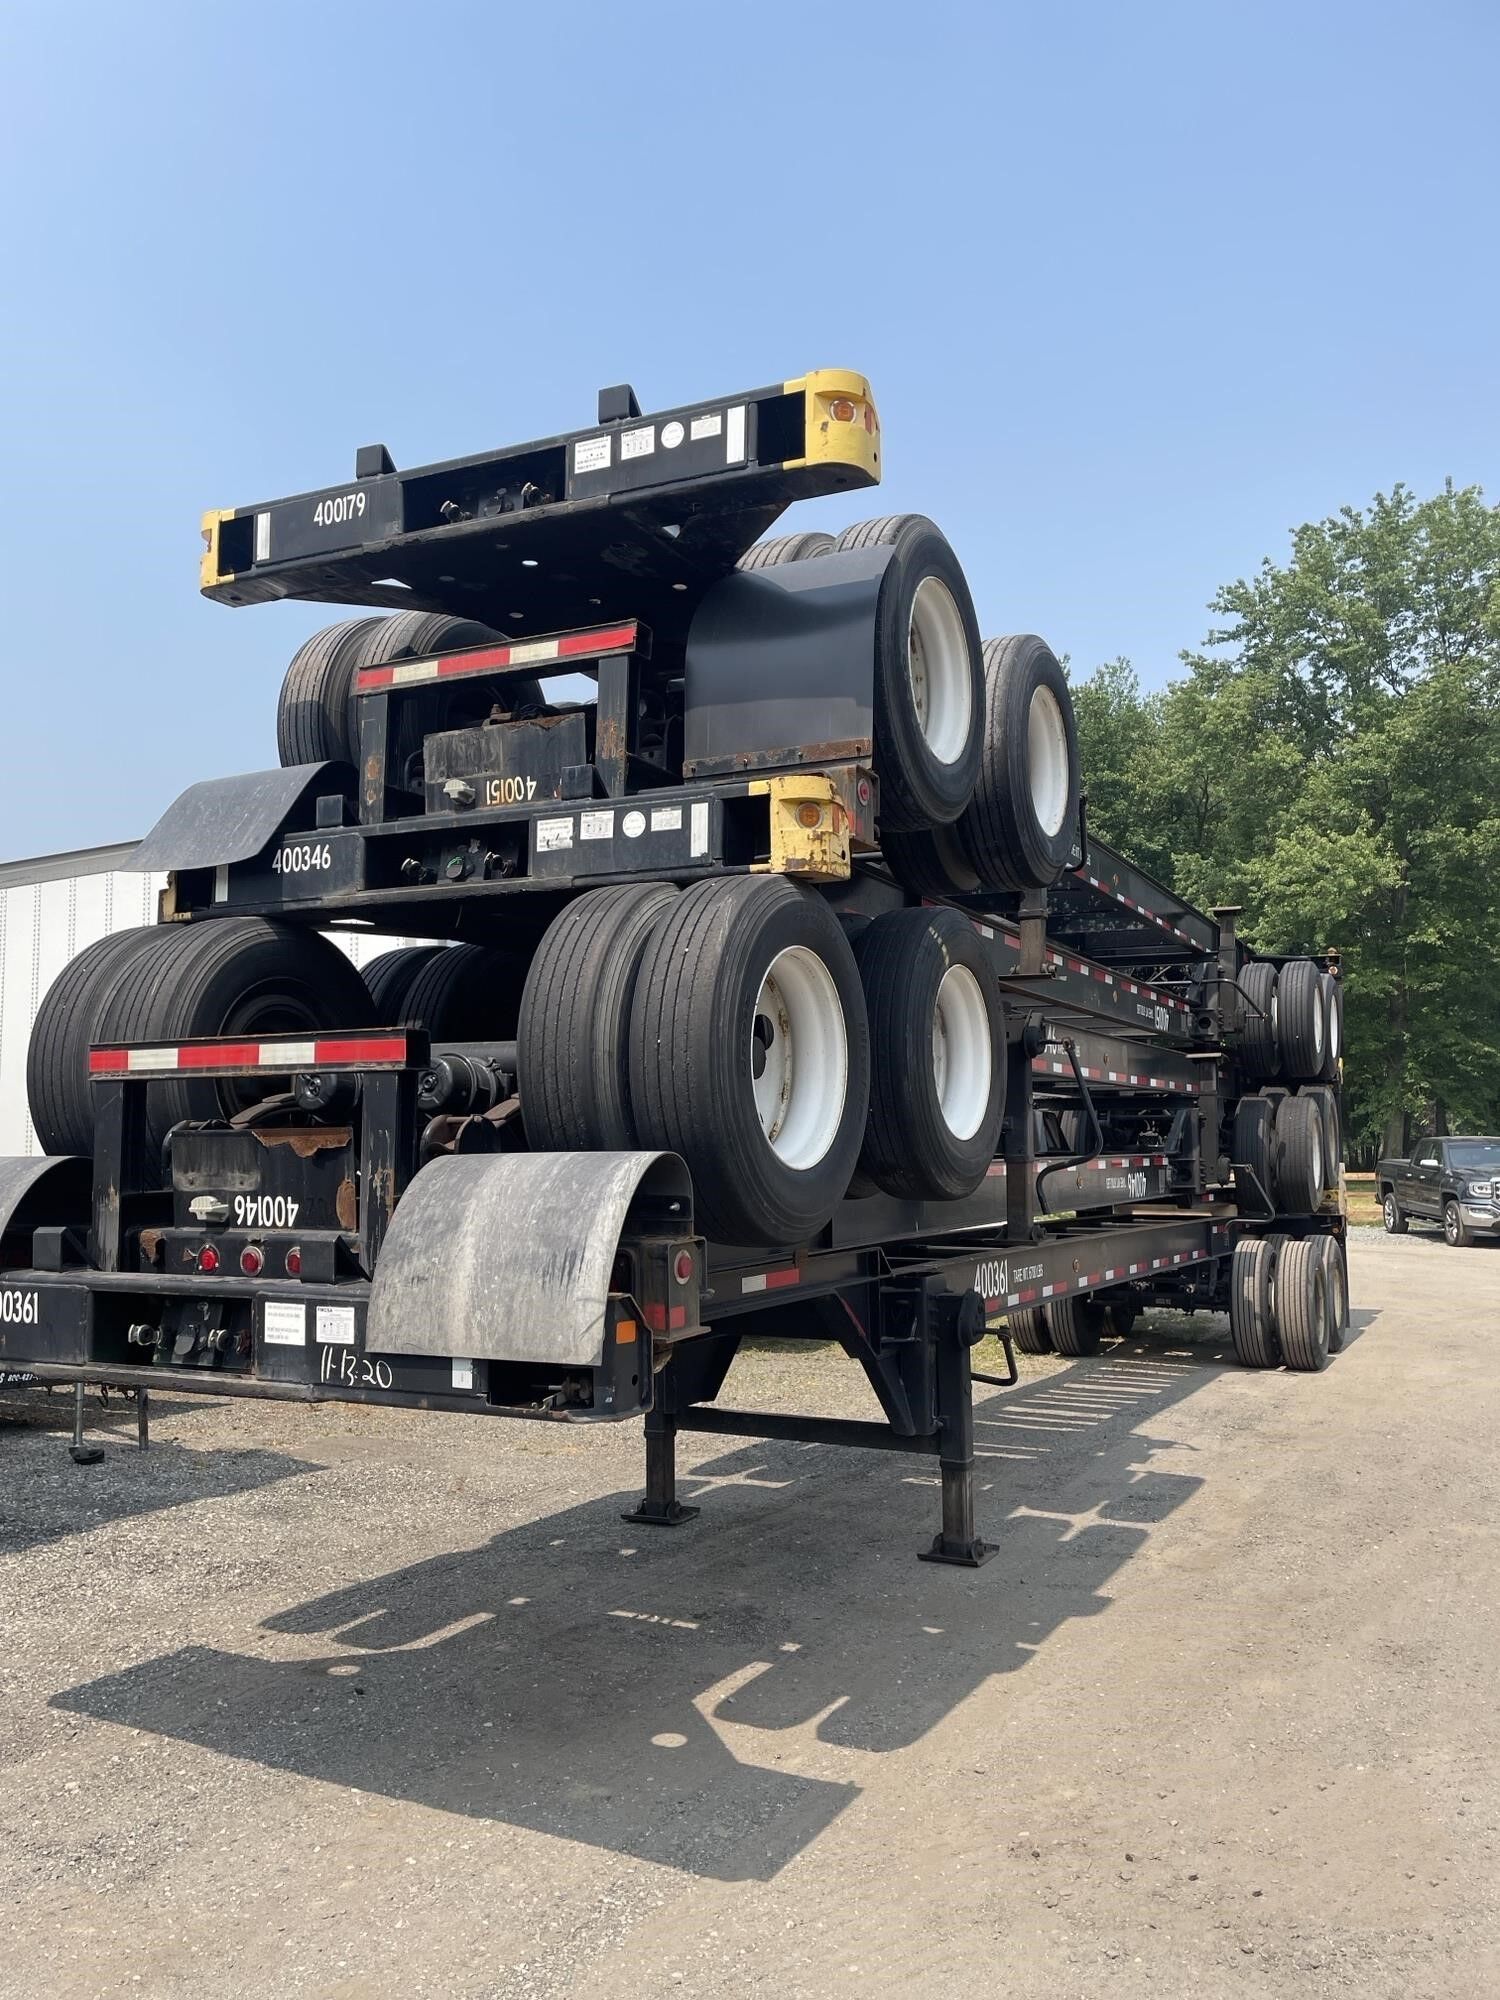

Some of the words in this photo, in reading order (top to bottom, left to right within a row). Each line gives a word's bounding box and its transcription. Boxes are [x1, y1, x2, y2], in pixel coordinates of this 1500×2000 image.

[313, 491, 366, 527] 400179
[486, 775, 537, 806] 400151
[271, 844, 331, 874] 400346
[234, 1194, 299, 1228] 400146
[973, 1258, 1008, 1299] 400361
[0, 1290, 39, 1324] 0361
